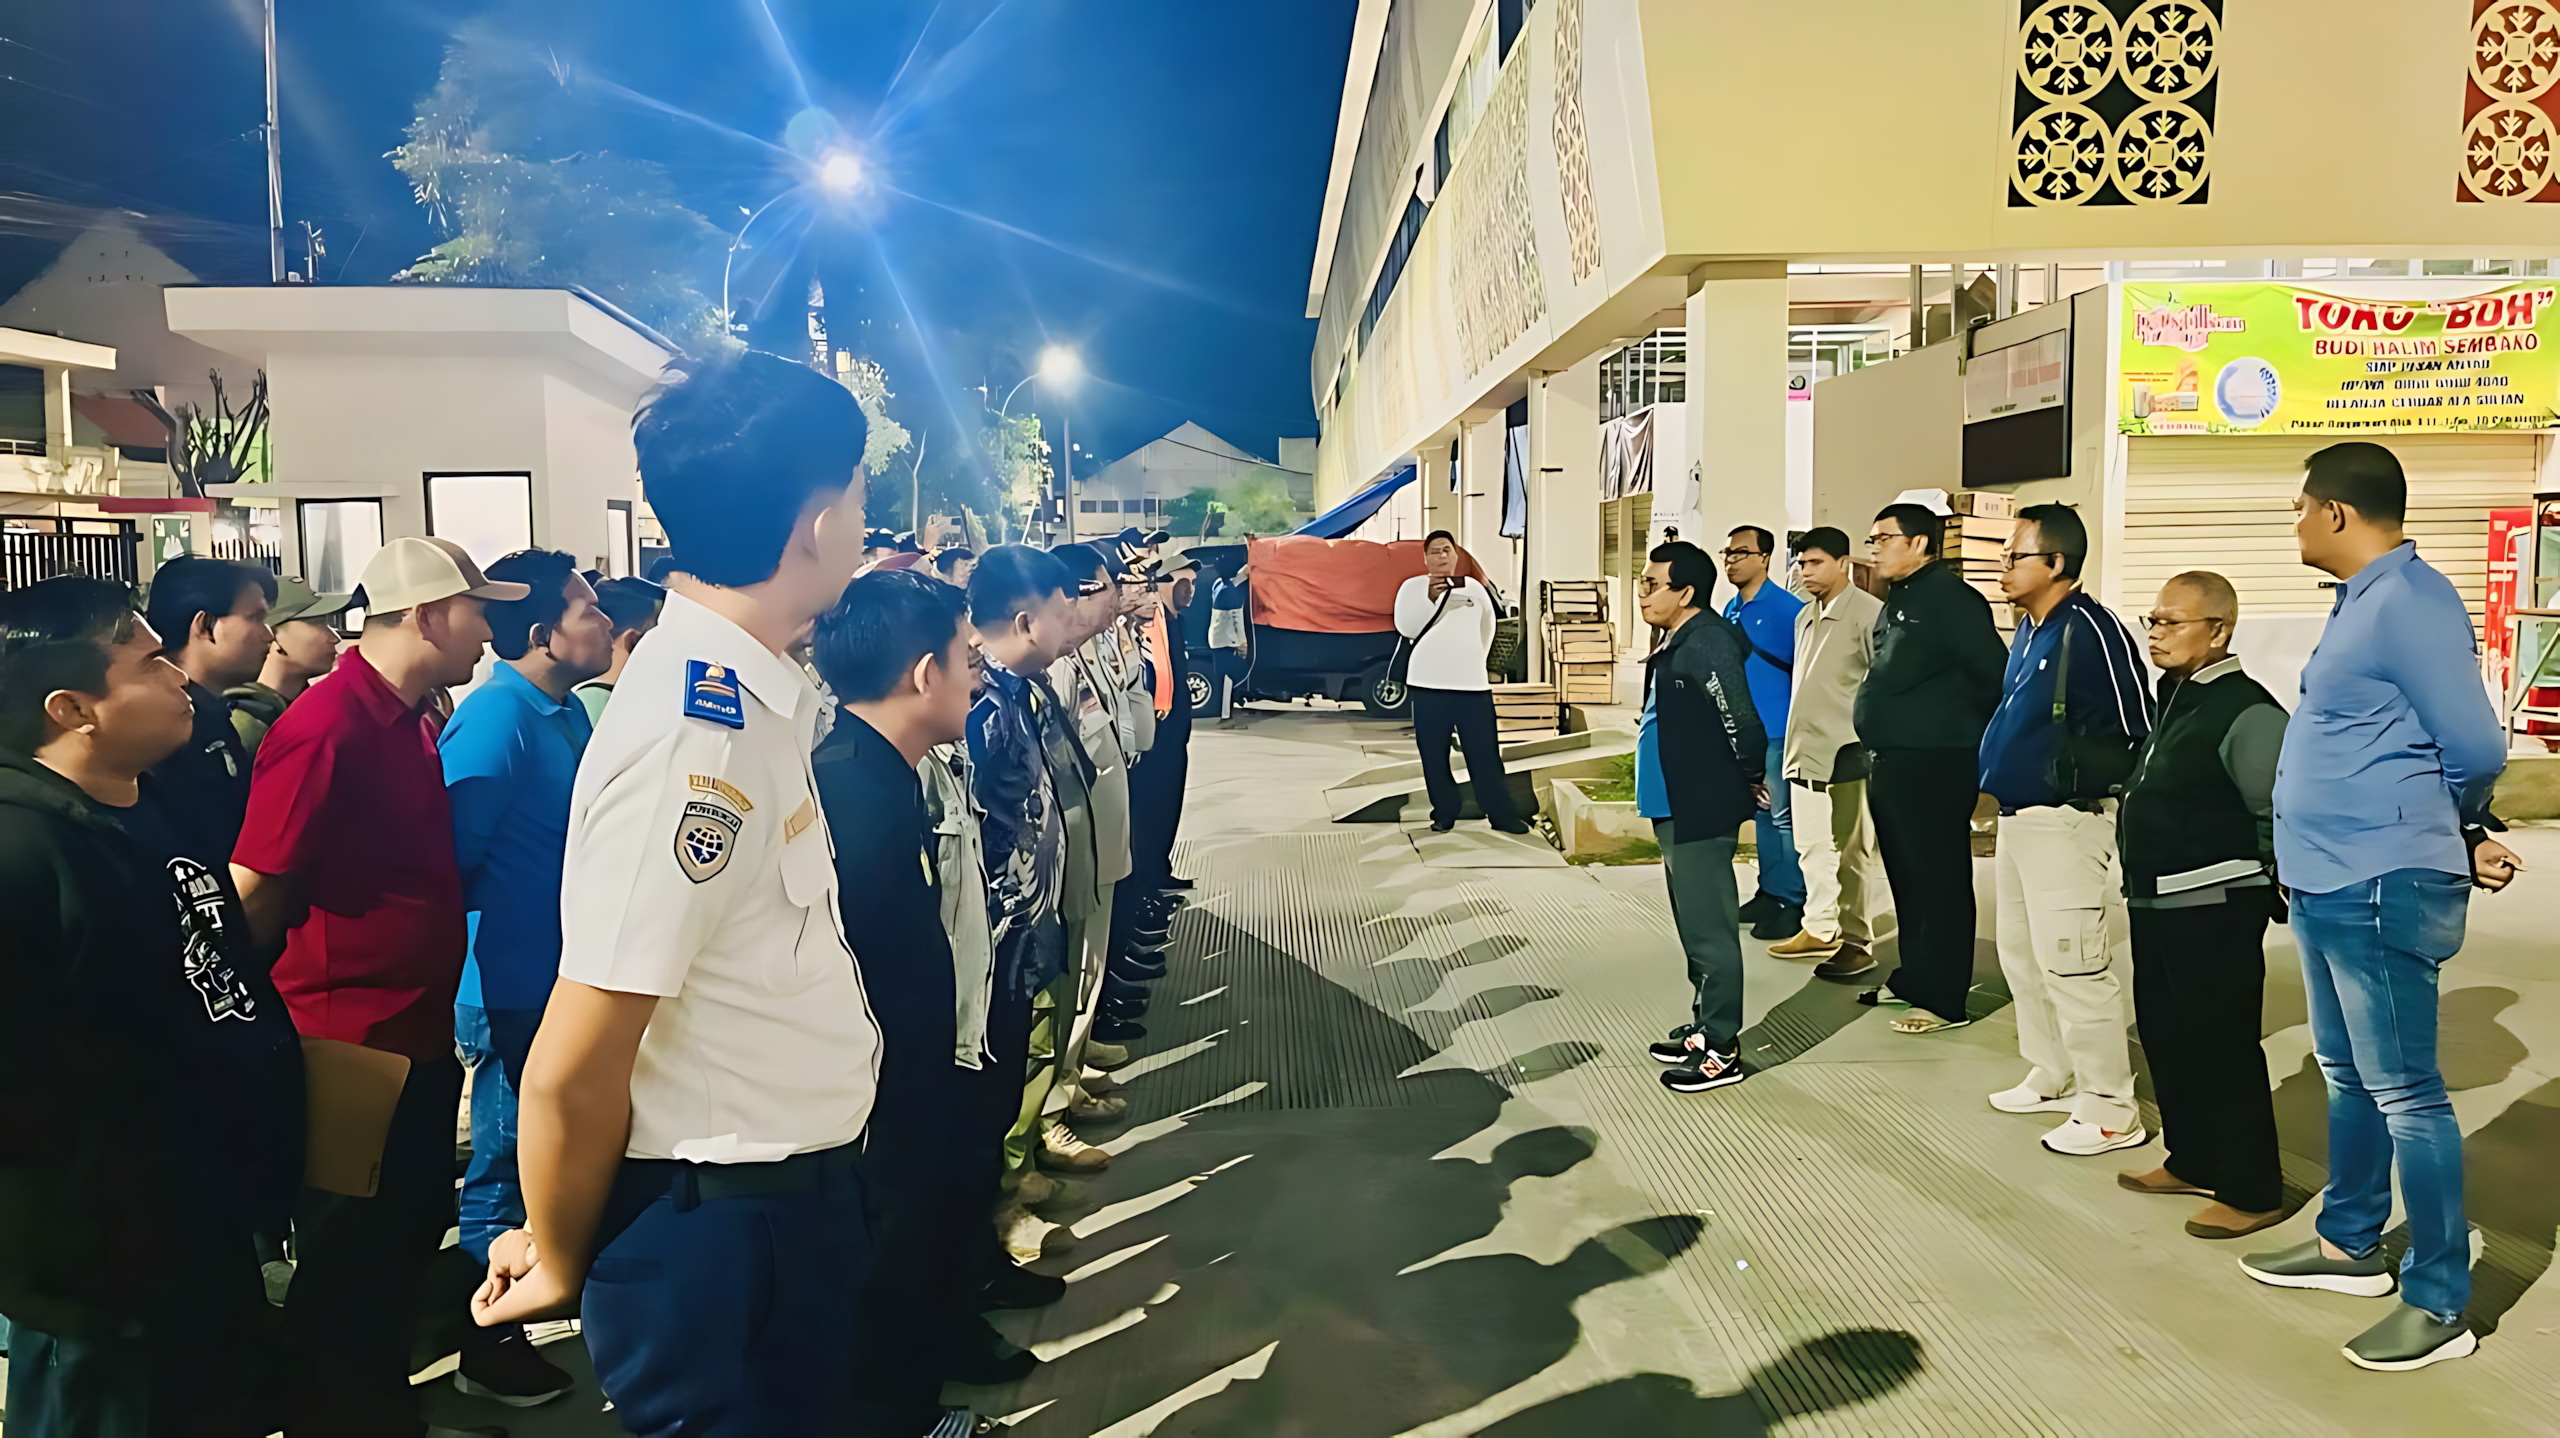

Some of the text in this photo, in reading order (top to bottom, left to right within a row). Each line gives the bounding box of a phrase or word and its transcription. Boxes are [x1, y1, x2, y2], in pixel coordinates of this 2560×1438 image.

[2316, 333, 2538, 355] BUDI HALIM SEMBAKO
